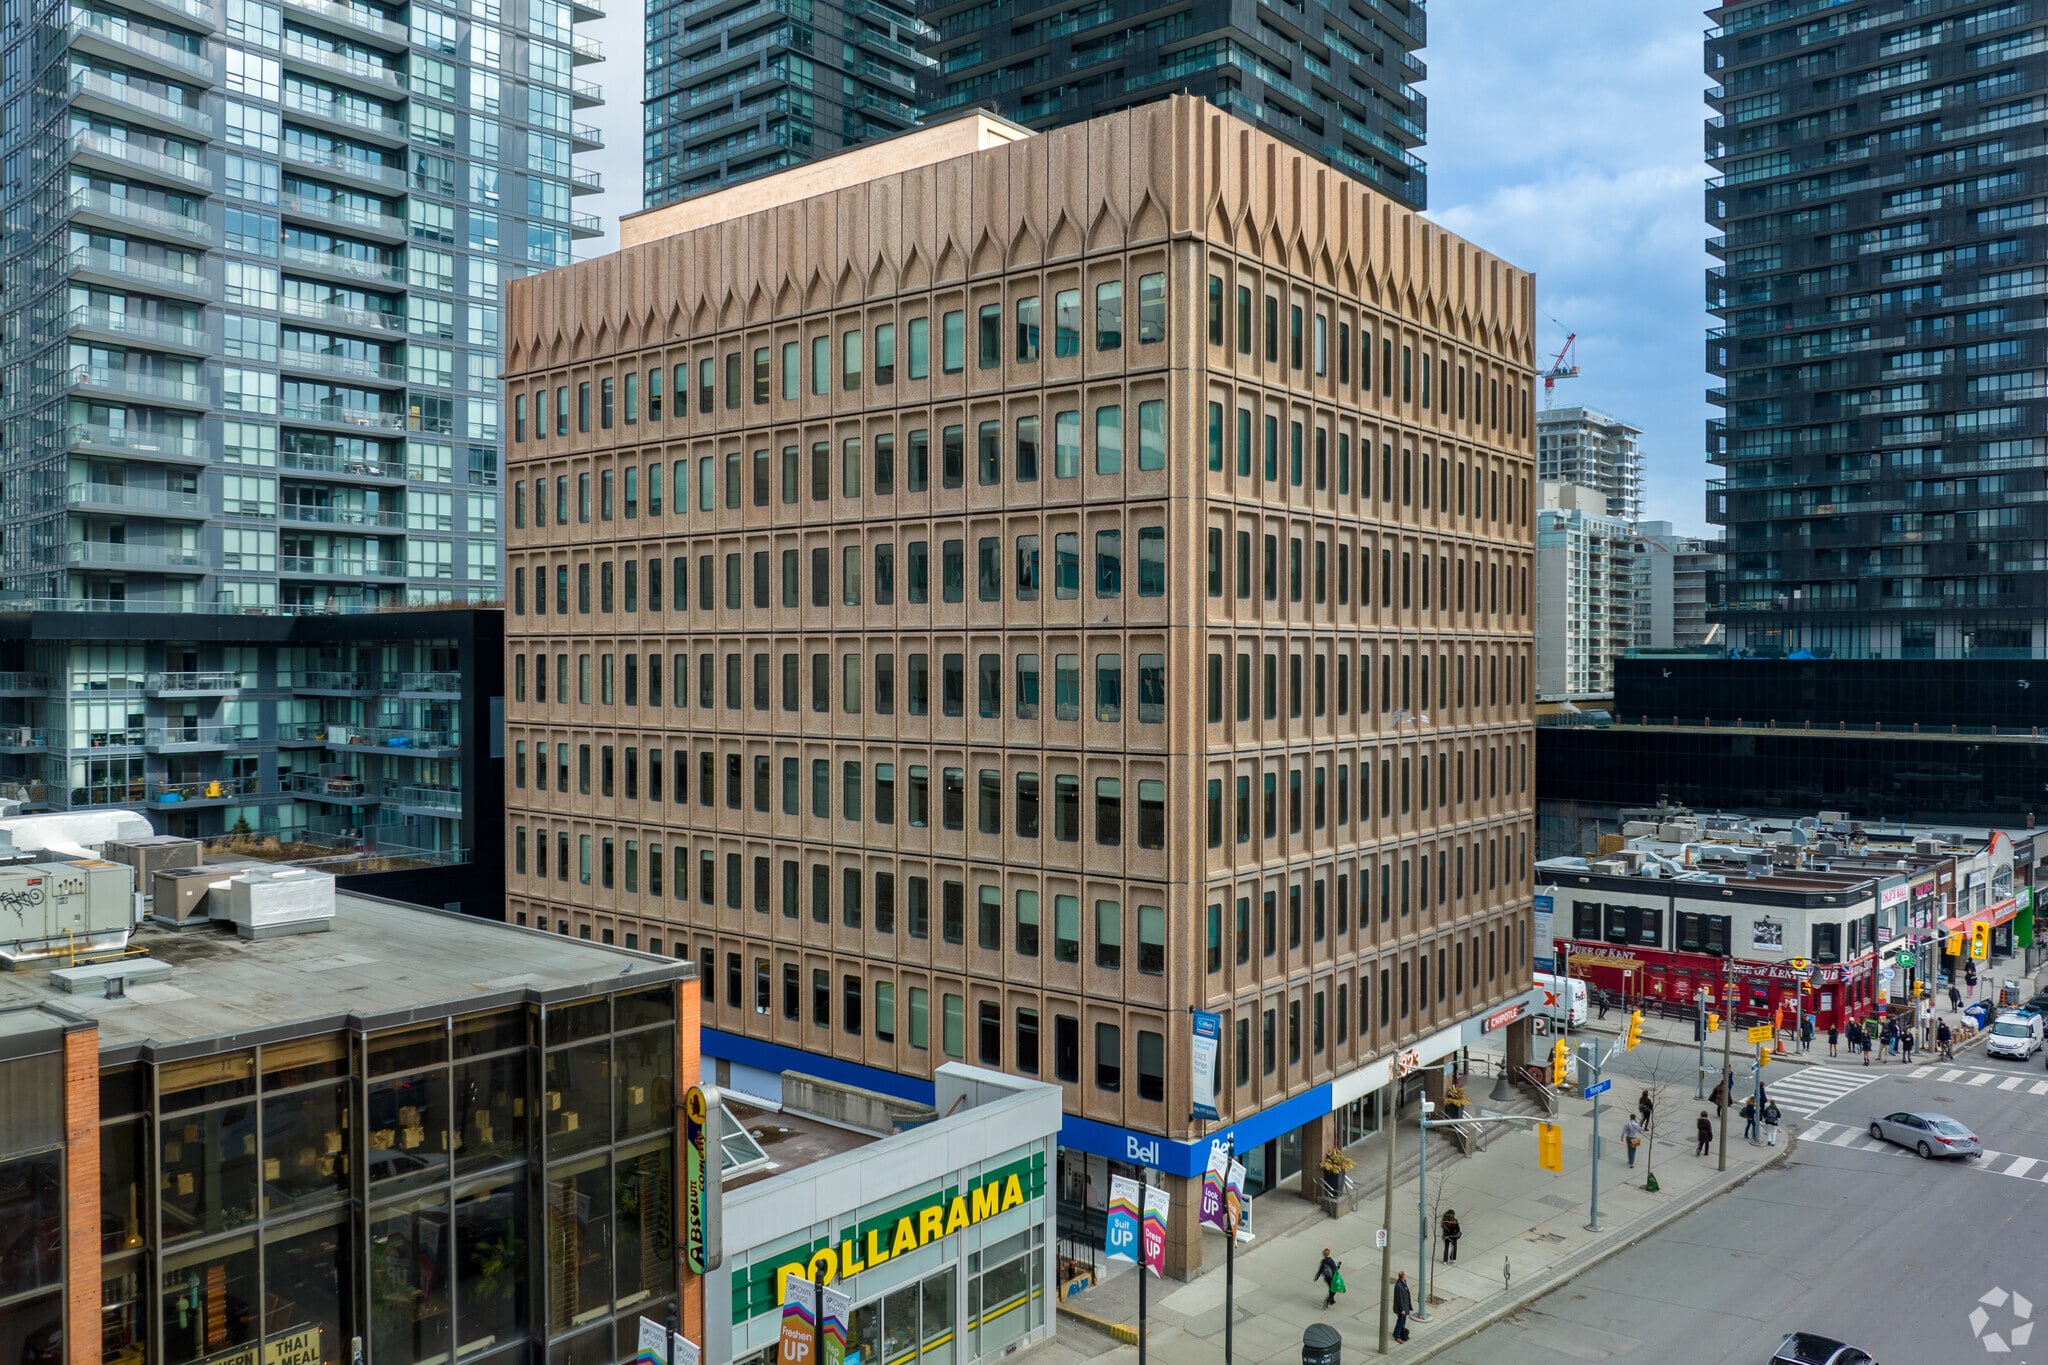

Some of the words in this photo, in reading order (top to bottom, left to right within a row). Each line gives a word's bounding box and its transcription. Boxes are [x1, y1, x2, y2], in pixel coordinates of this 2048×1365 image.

[1568, 943, 1594, 956] DUKE
[1595, 949, 1607, 958] OF
[1608, 948, 1636, 961] KENT
[1901, 954, 1910, 966] P
[1754, 967, 1767, 977] OF
[1490, 1006, 1519, 1028] CHIPOTLE
[1590, 1083, 1603, 1096] Yonge
[1127, 1135, 1160, 1165] Bell
[1114, 1182, 1136, 1194] UPTOWN
[1115, 1189, 1134, 1200] YONGE
[1205, 1187, 1219, 1201] Look
[1147, 1192, 1167, 1206] UPTOWN
[1203, 1196, 1219, 1216] UP
[690, 1180, 706, 1268] ABSOLUTE
[1114, 1218, 1130, 1229] Suit
[777, 1173, 1024, 1306] DOLLARAMA
[1111, 1230, 1134, 1248] UP
[1145, 1228, 1162, 1244] Dress
[1145, 1238, 1161, 1260] UP
[788, 1283, 812, 1297] UPTOWN
[789, 1293, 810, 1305] YONGE
[825, 1295, 847, 1311] UPTOWN
[827, 1305, 844, 1318] YONGE
[782, 1325, 813, 1342] Freshen
[275, 1334, 308, 1357] THAI
[783, 1339, 810, 1363] UP
[281, 1348, 320, 1365] MEAL
